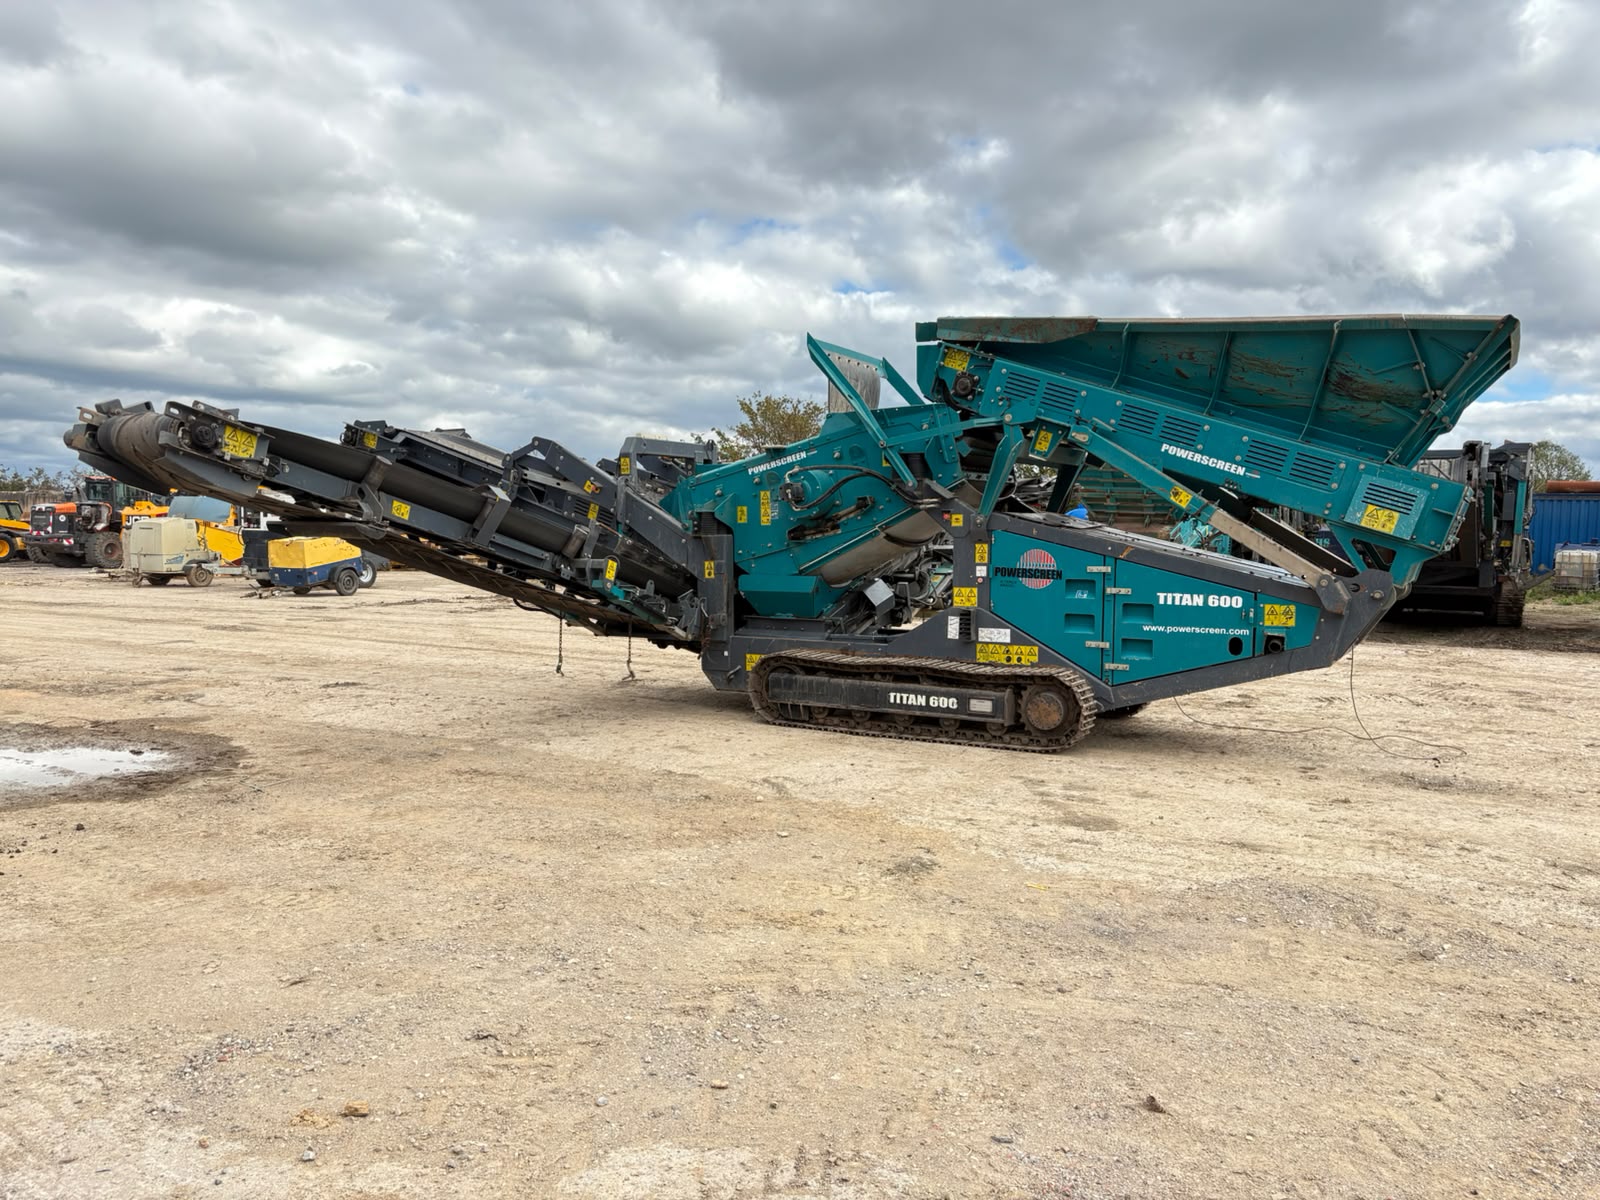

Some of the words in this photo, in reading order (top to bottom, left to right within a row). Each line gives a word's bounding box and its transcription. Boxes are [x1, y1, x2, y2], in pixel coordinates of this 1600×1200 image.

[747, 450, 807, 476] POWERSCREEN
[1161, 443, 1246, 476] POWERSCREEN
[994, 566, 1063, 581] POWERSCREEN
[1156, 592, 1204, 607] TITAN
[1207, 594, 1244, 609] 600
[1142, 624, 1250, 636] www.powerscreen.com
[888, 692, 926, 707] TITAN
[929, 695, 958, 710] 600
